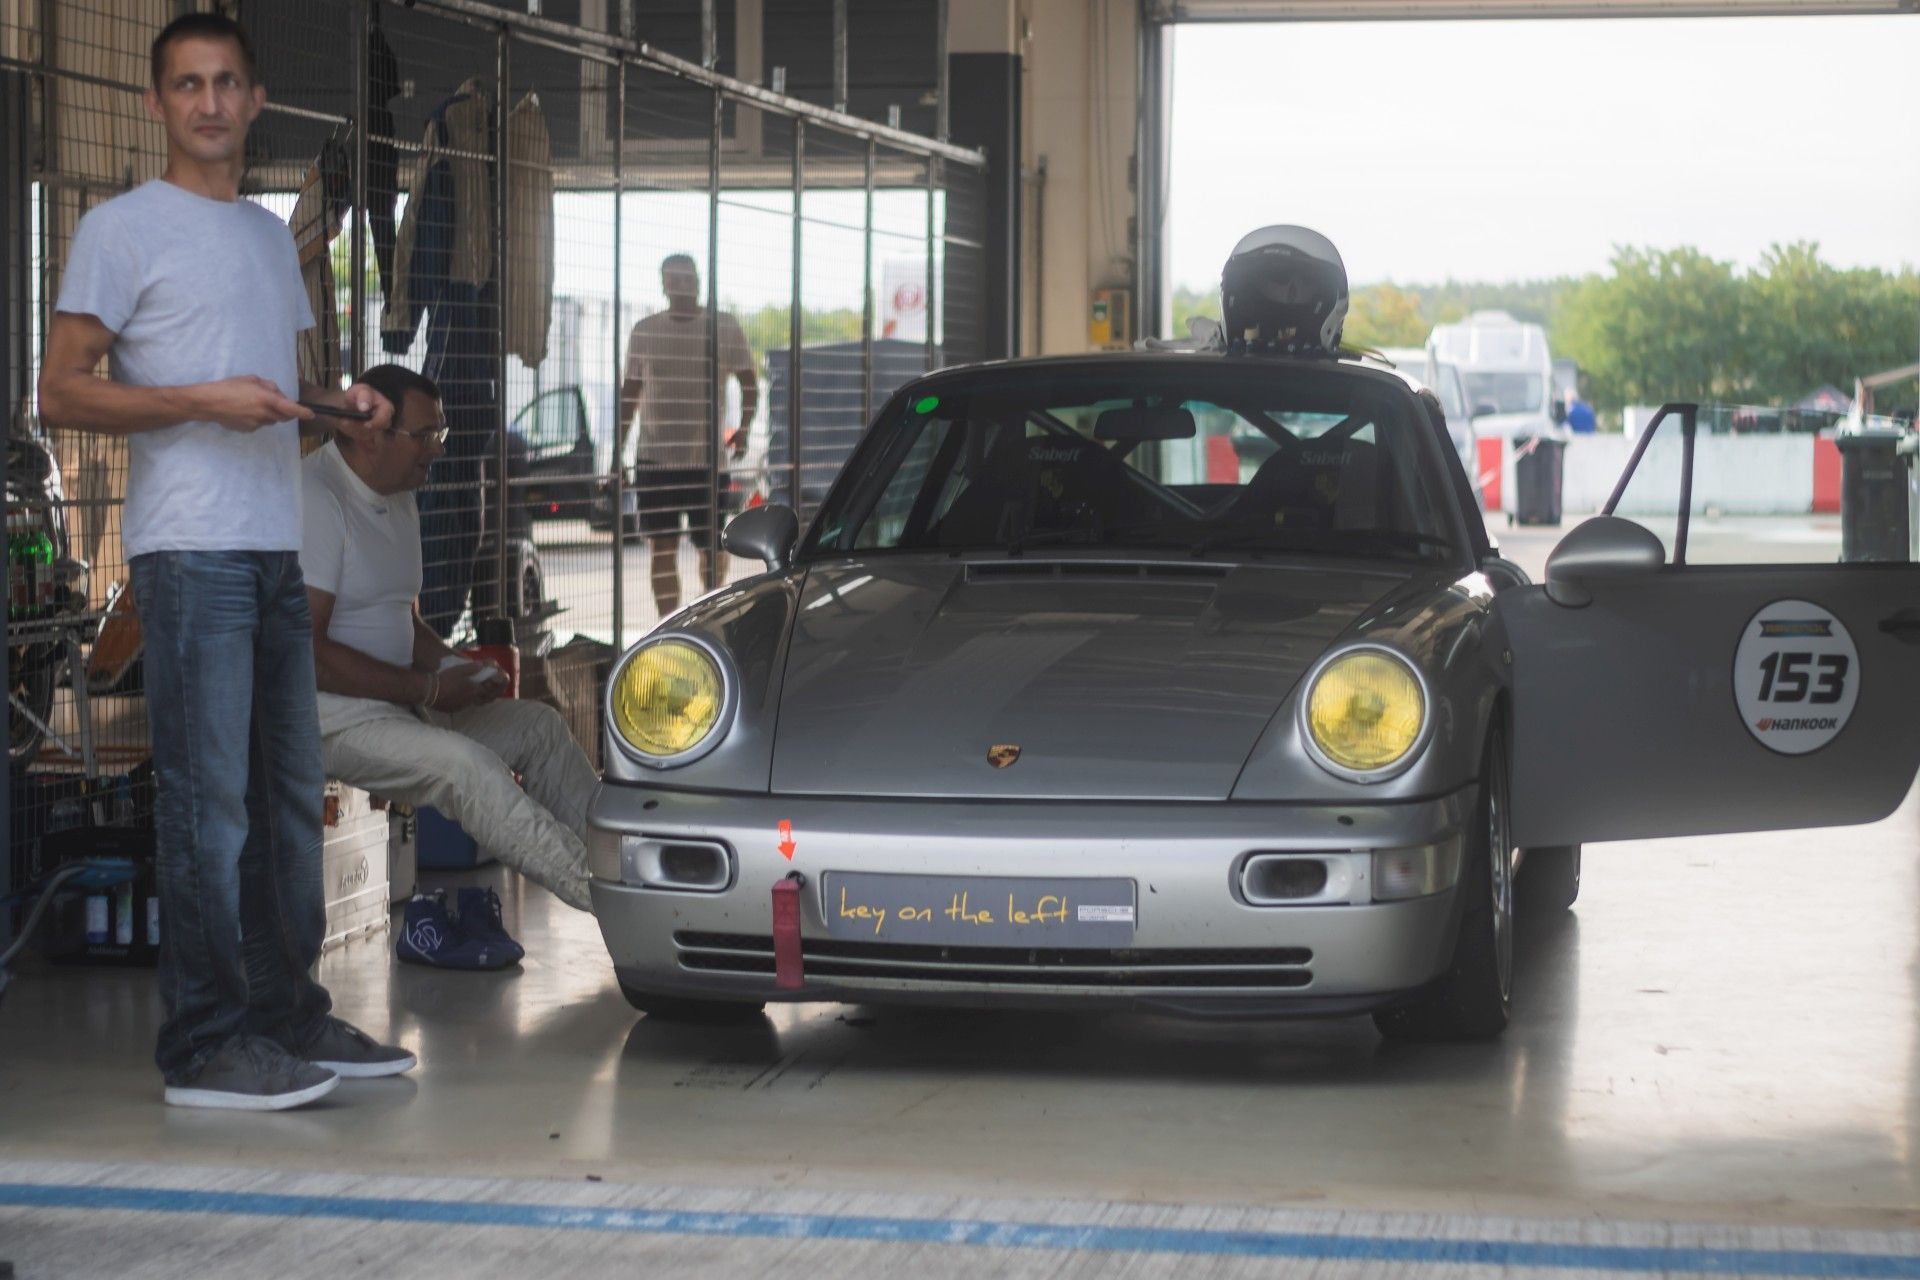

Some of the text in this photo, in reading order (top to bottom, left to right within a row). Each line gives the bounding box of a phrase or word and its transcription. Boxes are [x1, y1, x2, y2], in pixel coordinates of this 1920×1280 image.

[1758, 651, 1849, 704] 153
[840, 886, 886, 935] key
[898, 906, 932, 922] on
[944, 891, 994, 926] the
[1008, 892, 1069, 924] left
